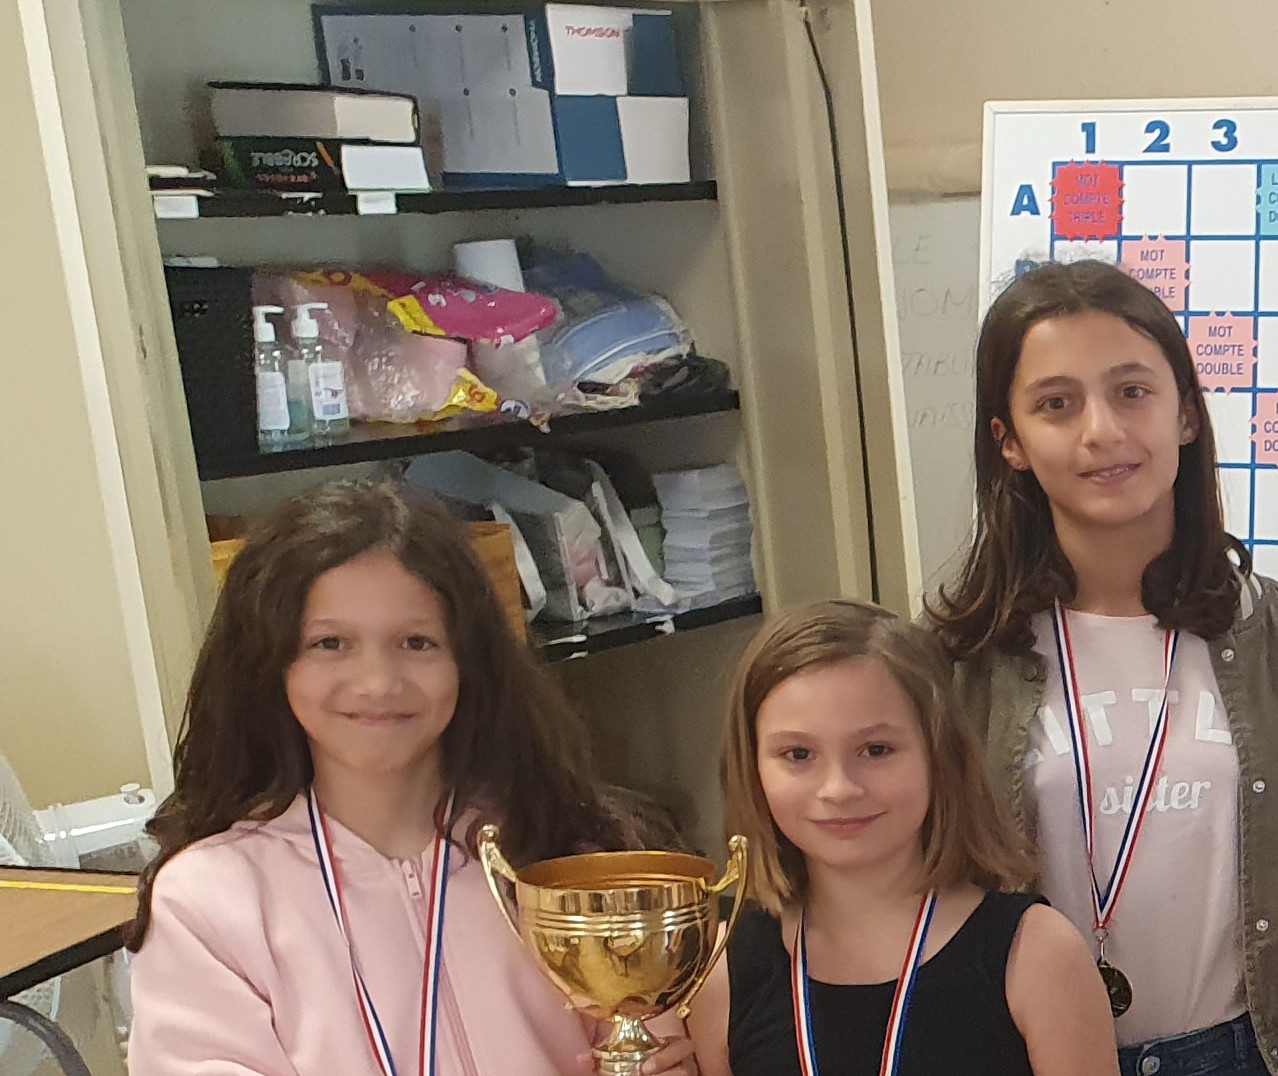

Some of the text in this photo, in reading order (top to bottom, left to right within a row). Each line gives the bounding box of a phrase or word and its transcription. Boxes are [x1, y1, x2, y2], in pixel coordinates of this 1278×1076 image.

[565, 25, 620, 38] THOMSON
[1080, 122, 1097, 154] 1
[1143, 120, 1171, 152] 2
[1211, 119, 1238, 151] 3
[1076, 174, 1099, 187] MOT
[1010, 184, 1040, 217] A
[1064, 193, 1109, 206] COMPTE
[1068, 211, 1105, 223] TRIPLE
[1140, 250, 1165, 262] MOT
[1150, 286, 1176, 298] BLE
[1207, 325, 1233, 339] MOT
[1196, 343, 1245, 357] COMPTE
[1196, 361, 1244, 375] DOUBLE
[1038, 688, 1233, 756] ITTL
[1100, 775, 1211, 815] siter
